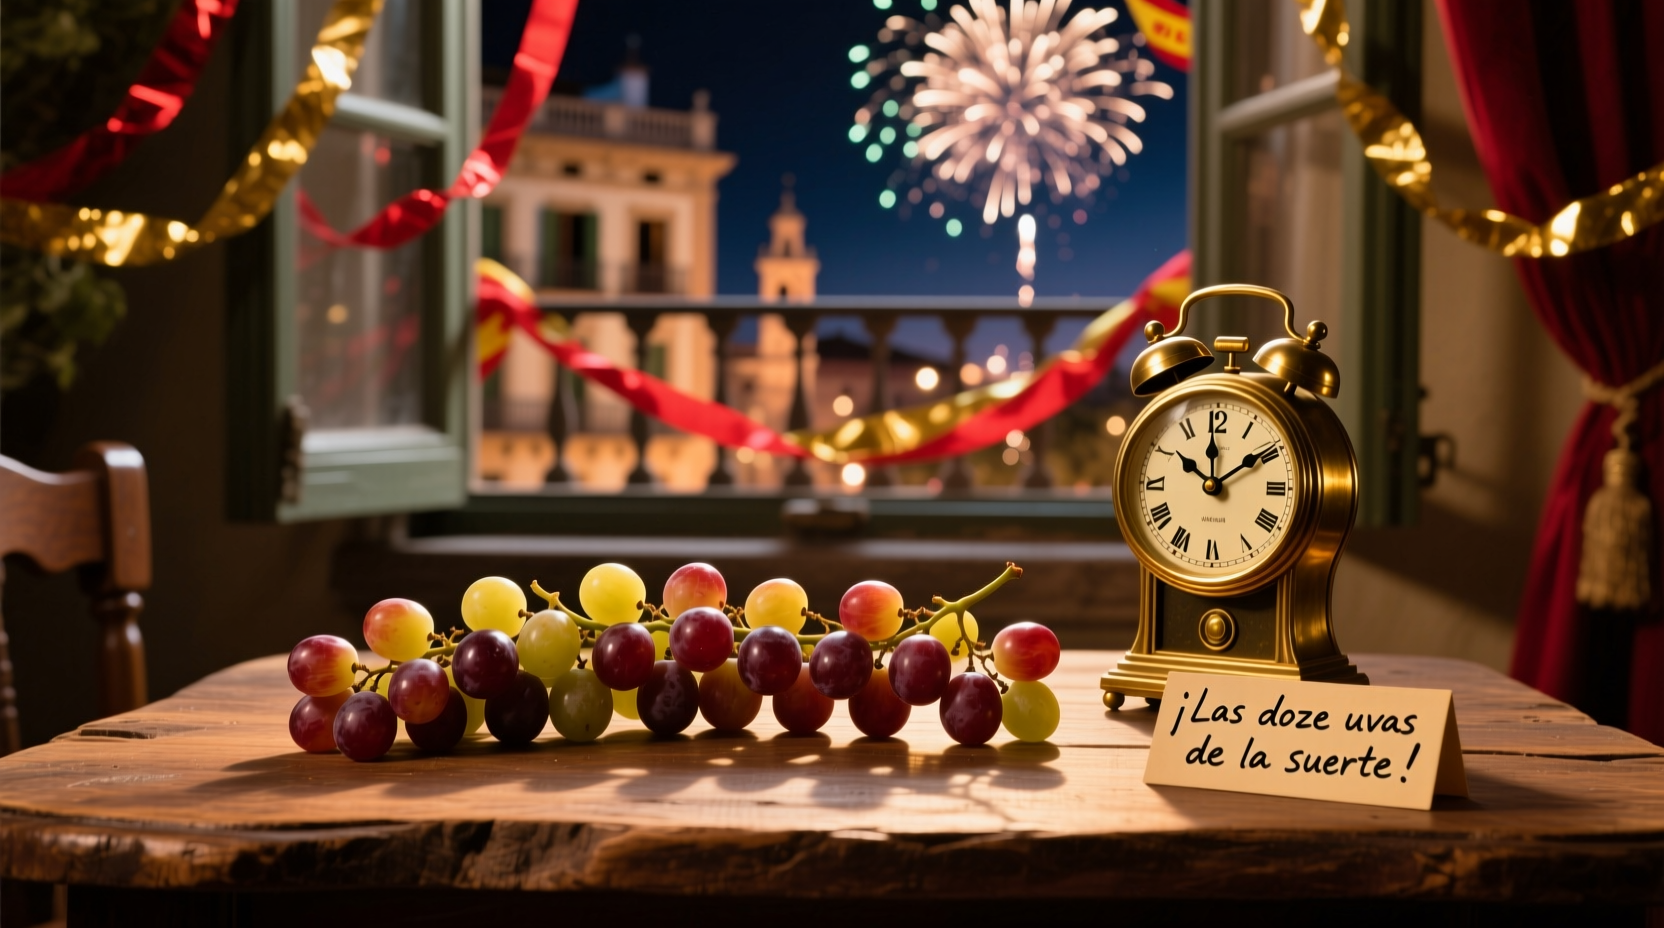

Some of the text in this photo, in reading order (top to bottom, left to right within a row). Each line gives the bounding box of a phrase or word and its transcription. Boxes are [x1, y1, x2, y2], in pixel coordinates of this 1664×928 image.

[1208, 410, 1228, 433] 12
[1242, 421, 1254, 439] I
[1266, 481, 1286, 496] III
[1170, 687, 1418, 736] ¡Las doze uvas
[1185, 734, 1224, 767] de
[1239, 736, 1271, 769] la
